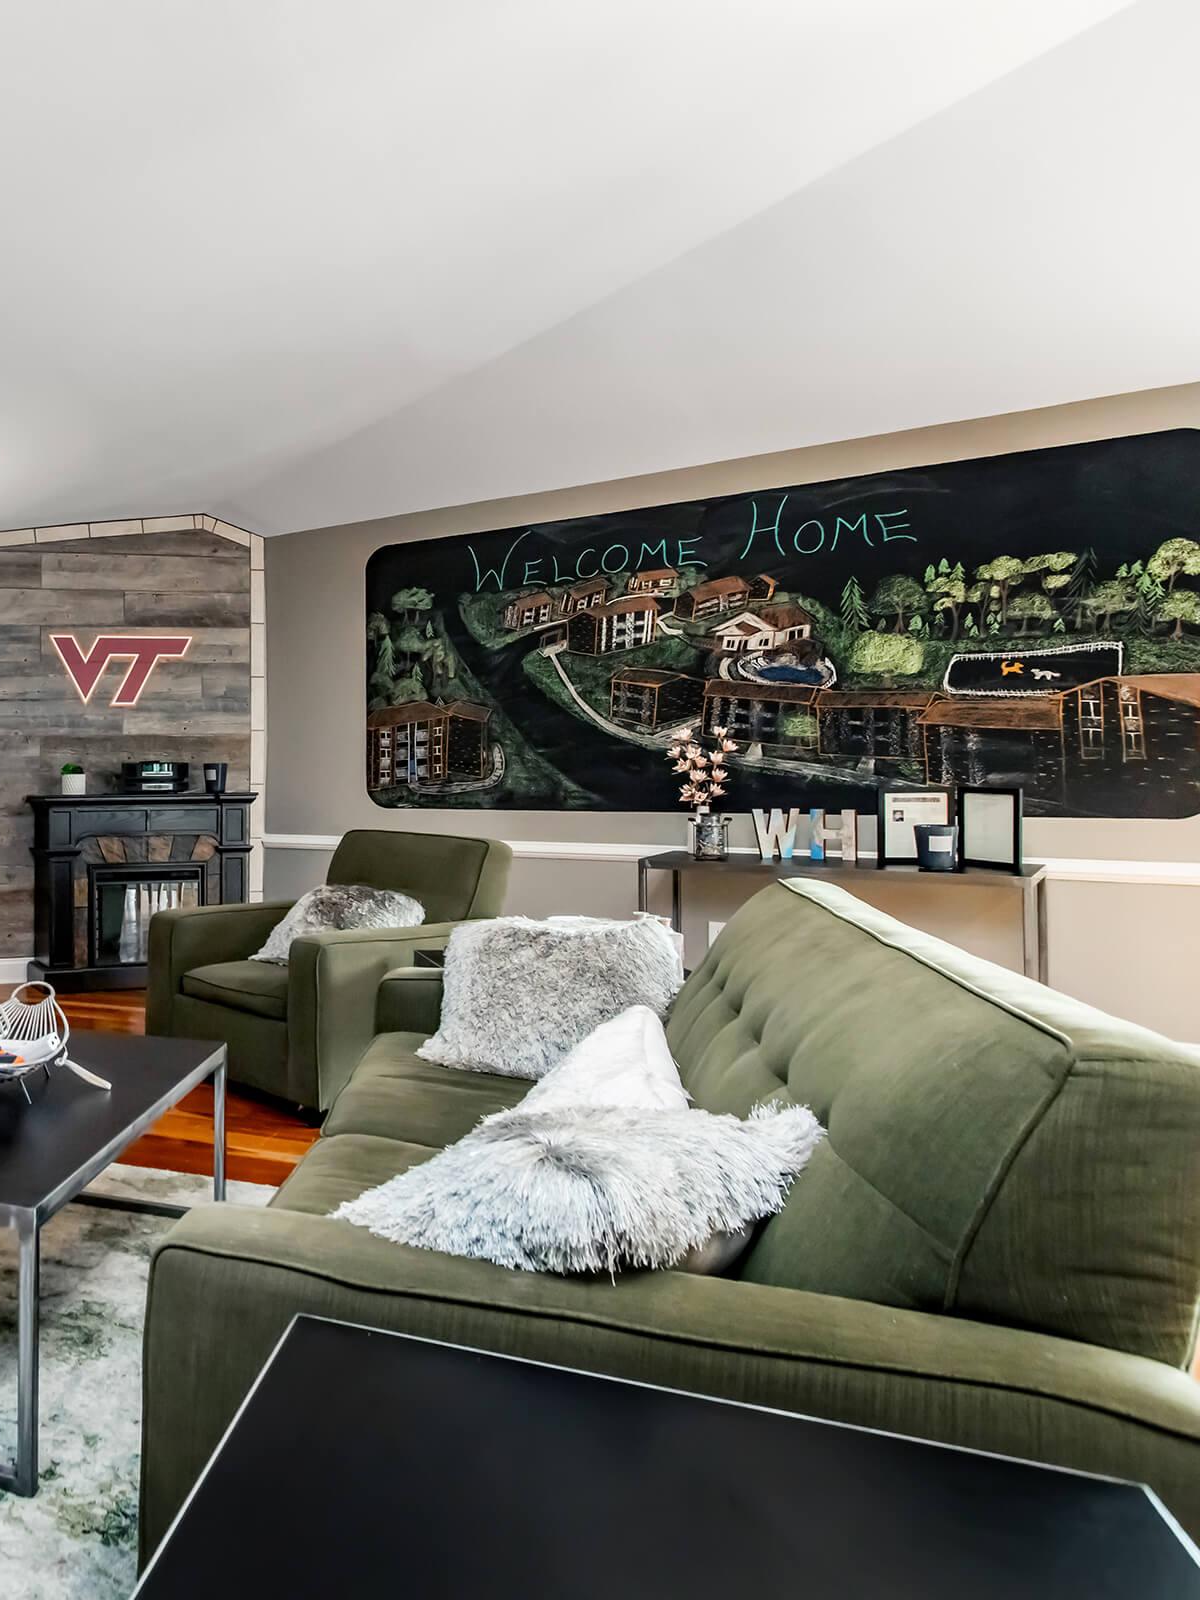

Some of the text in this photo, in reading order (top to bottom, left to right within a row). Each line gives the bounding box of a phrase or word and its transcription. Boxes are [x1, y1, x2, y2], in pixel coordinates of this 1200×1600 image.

[467, 494, 918, 592] WELCOME HOME
[50, 634, 193, 706] VT
